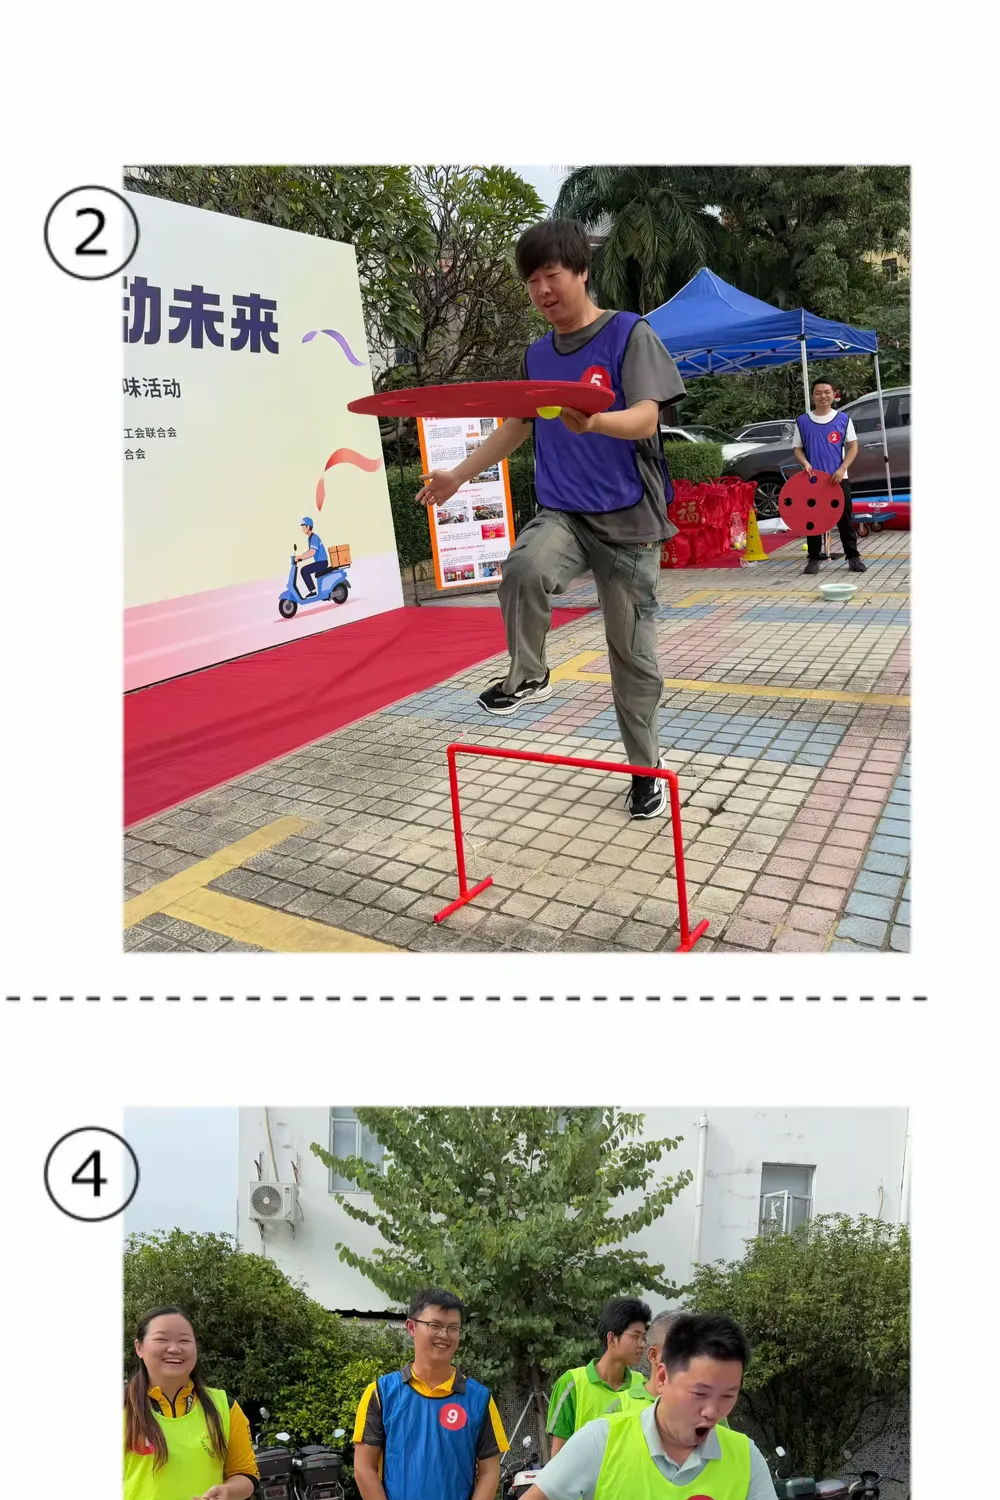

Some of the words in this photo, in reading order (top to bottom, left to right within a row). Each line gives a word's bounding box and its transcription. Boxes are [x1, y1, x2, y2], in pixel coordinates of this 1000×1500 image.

[123, 377, 181, 399] 味活动
[124, 427, 177, 439] 工会联合会
[124, 448, 146, 460] 合会
[446, 1409, 459, 1424] 9
